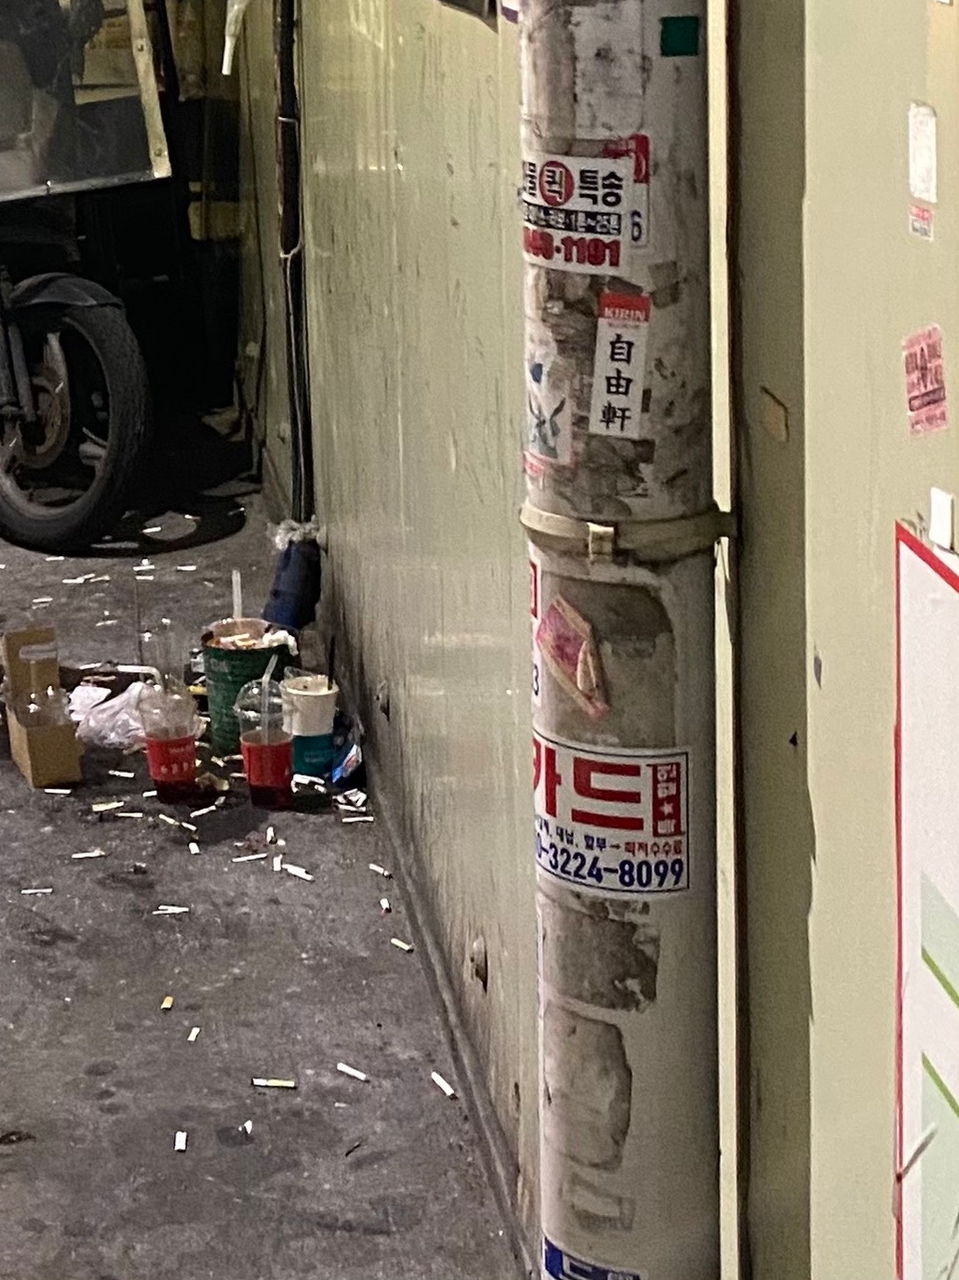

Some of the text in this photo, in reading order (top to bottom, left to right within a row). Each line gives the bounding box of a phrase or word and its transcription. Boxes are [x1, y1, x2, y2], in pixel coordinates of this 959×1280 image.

[603, 306, 646, 322] KIRIN
[600, 333, 635, 433] 自由軒
